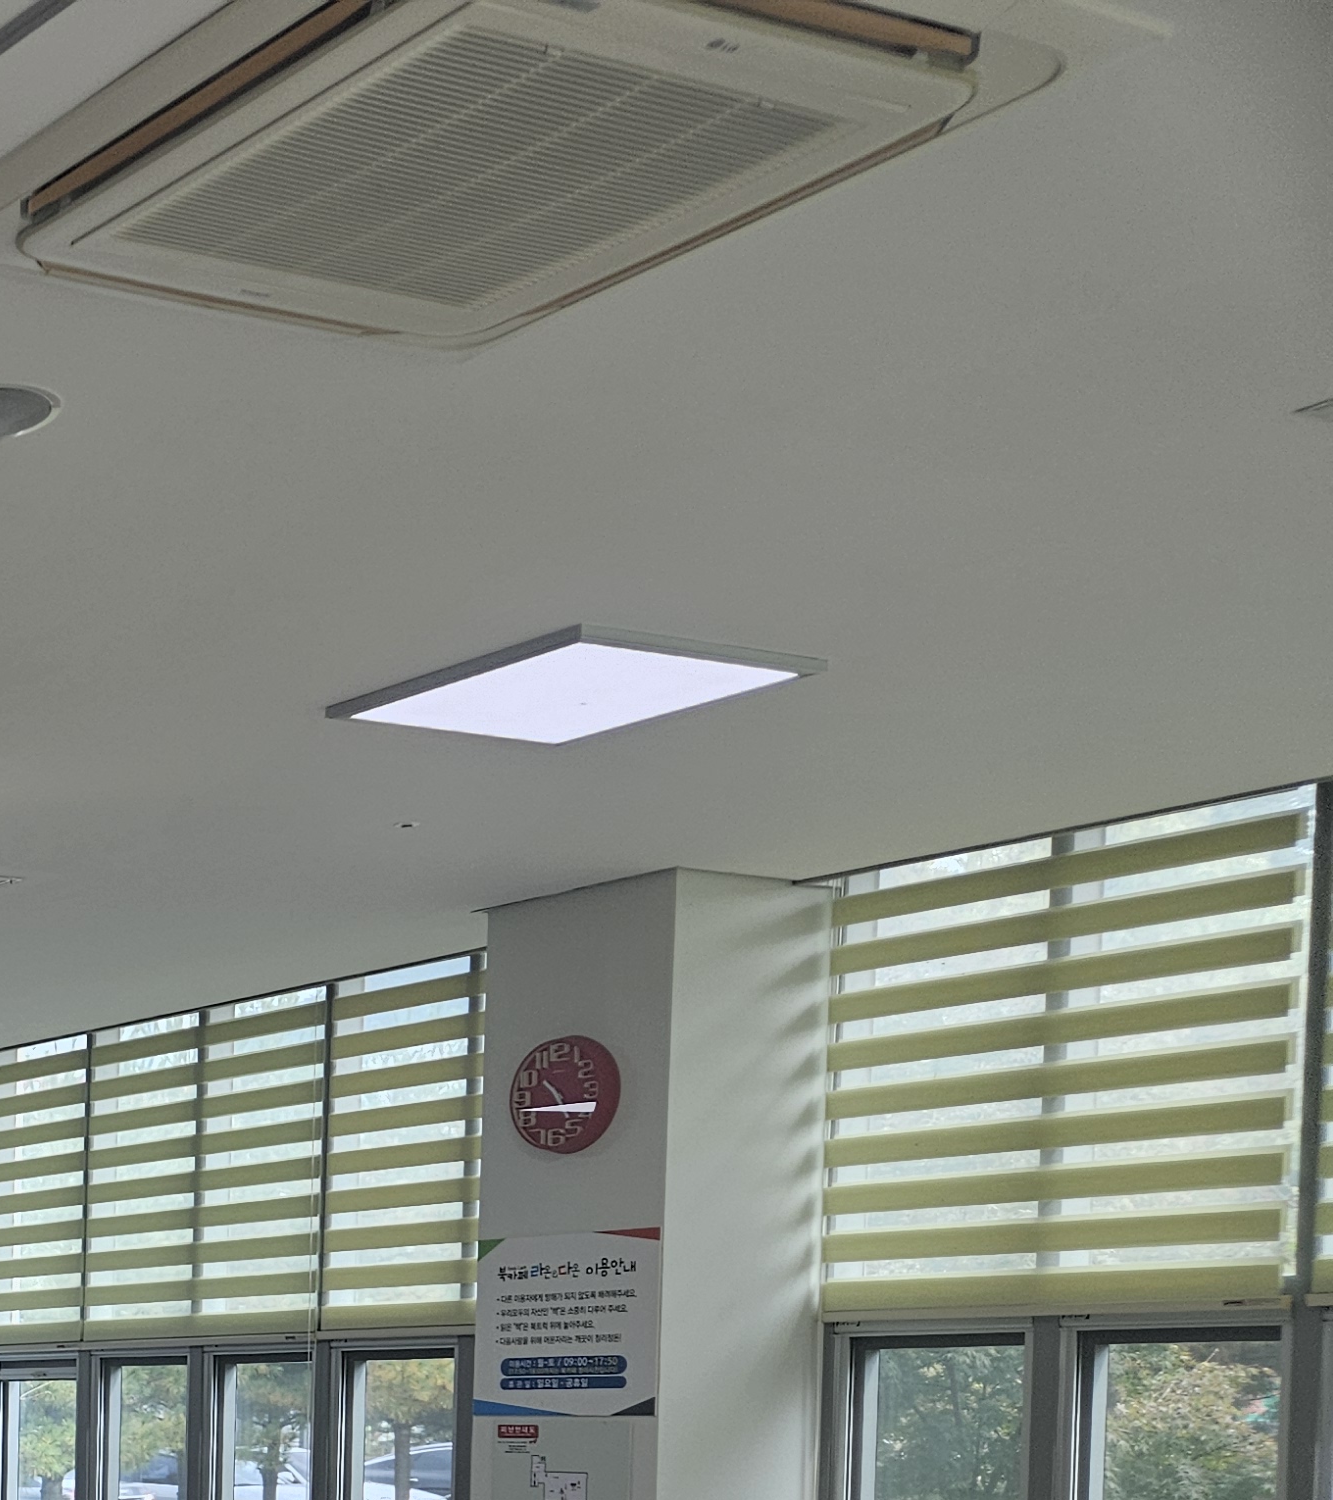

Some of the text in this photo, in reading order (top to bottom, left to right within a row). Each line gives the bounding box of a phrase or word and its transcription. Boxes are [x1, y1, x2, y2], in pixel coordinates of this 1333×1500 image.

[535, 1051, 549, 1069] 11
[549, 1043, 571, 1061] 12
[574, 1045, 581, 1063] 1
[519, 1069, 538, 1088] 10
[577, 1060, 595, 1079] 2
[583, 1081, 599, 1099] 3
[514, 1091, 532, 1108] 9
[518, 1110, 537, 1127] 8
[529, 1128, 547, 1145] 7
[547, 1128, 566, 1146] 6
[565, 1119, 584, 1137] 5
[497, 1266, 528, 1282] 북카페
[586, 1257, 636, 1277] 이용안내
[501, 1295, 512, 1303] 다른
[514, 1294, 543, 1303] 이용자에게
[564, 1292, 577, 1301] 되지
[578, 1291, 596, 1300] 않도록
[501, 1308, 529, 1317] 우리모두의
[530, 1308, 549, 1316] 자산인
[568, 1306, 586, 1315] 소중히
[587, 1305, 606, 1314] 다루어
